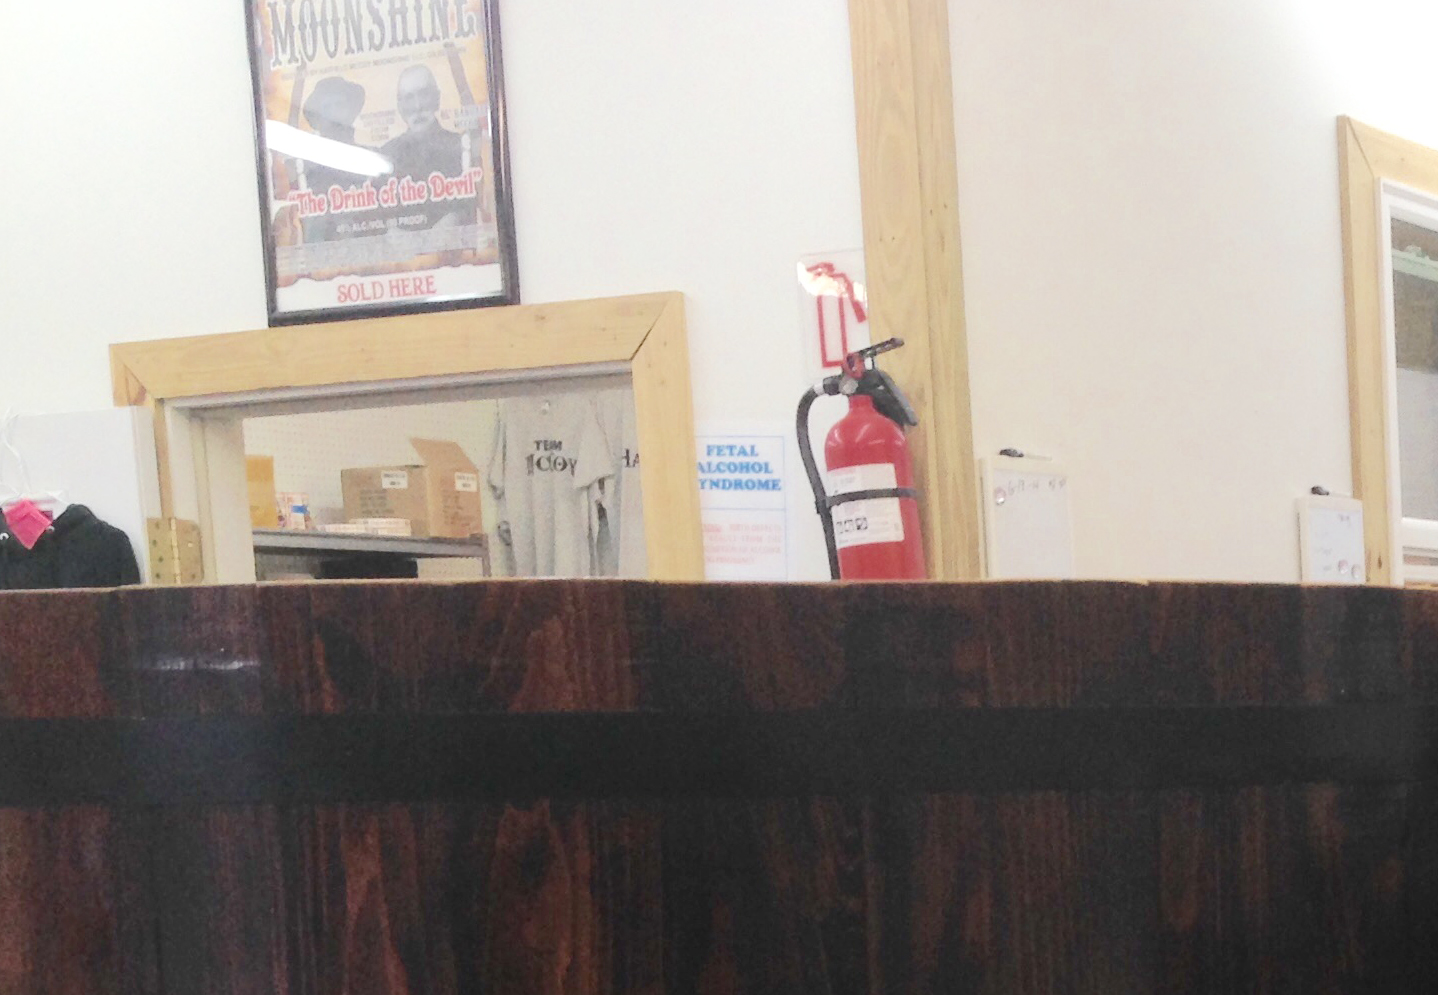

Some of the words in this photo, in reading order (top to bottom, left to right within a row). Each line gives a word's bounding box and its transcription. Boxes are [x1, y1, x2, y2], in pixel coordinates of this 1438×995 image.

[329, 182, 376, 210] Drink
[380, 178, 398, 205] of
[400, 178, 426, 201] the
[337, 281, 385, 303] SOLD
[389, 275, 438, 298] HERE
[706, 444, 759, 458] FETAL
[698, 479, 782, 491] YNDROME
